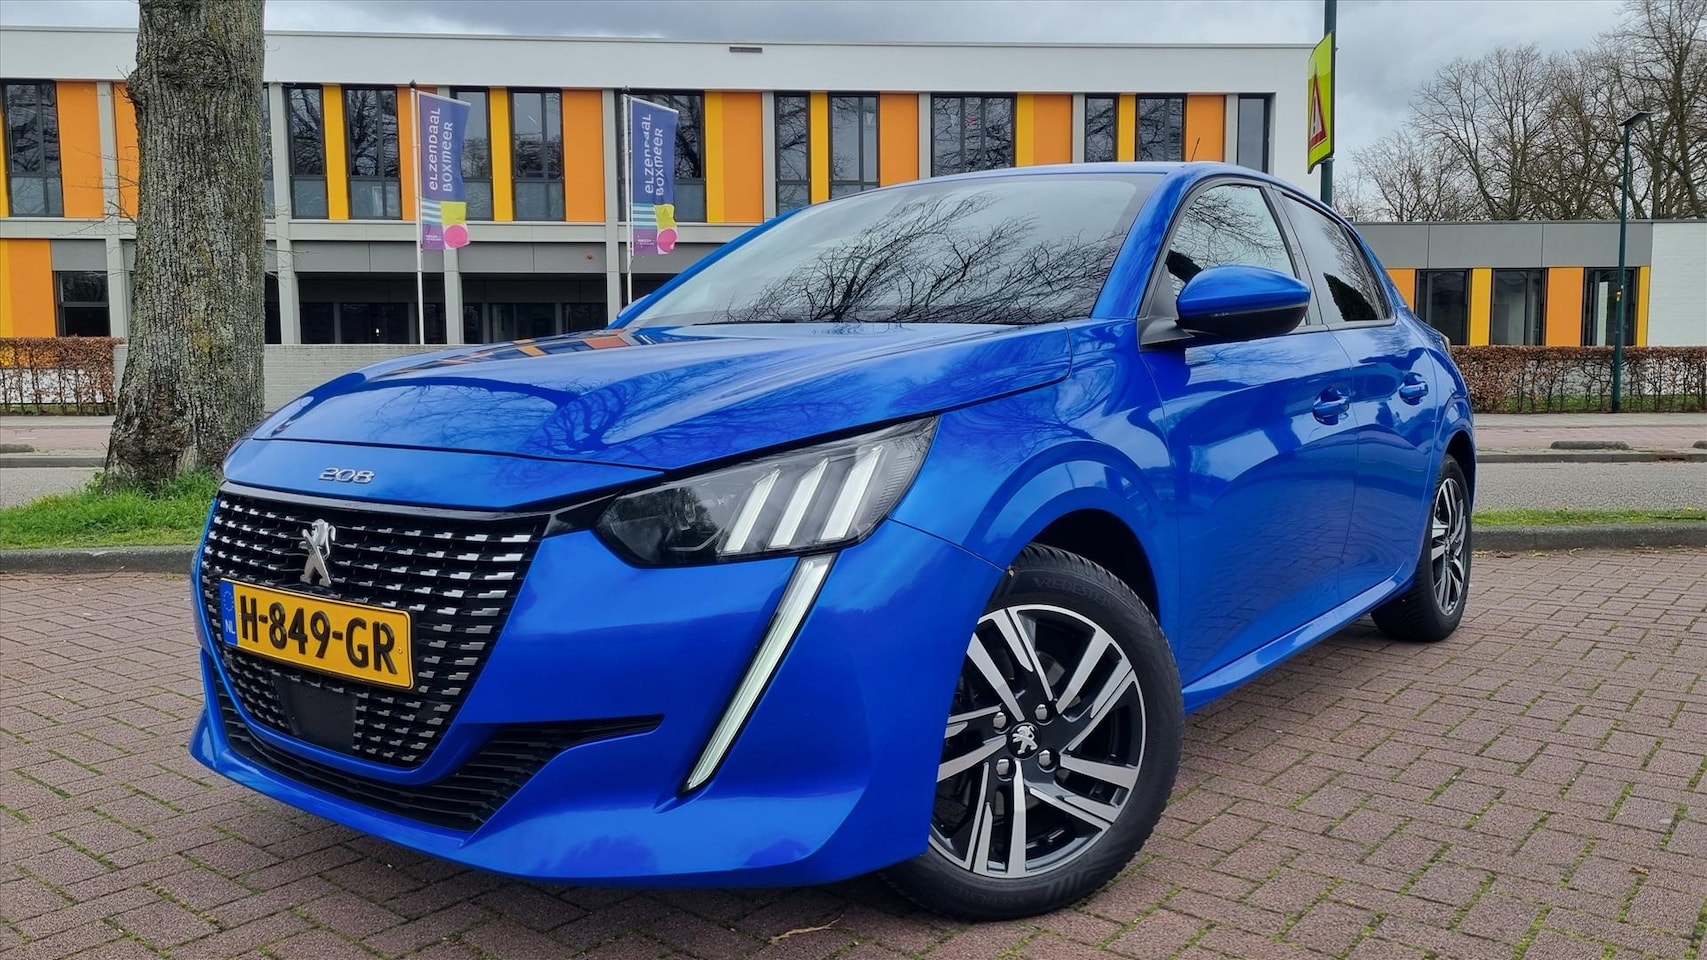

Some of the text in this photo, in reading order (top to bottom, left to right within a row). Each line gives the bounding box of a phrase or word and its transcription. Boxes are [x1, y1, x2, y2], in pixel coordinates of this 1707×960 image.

[318, 467, 375, 484] 208
[225, 621, 236, 634] NL
[239, 595, 399, 675] H-849-GR
